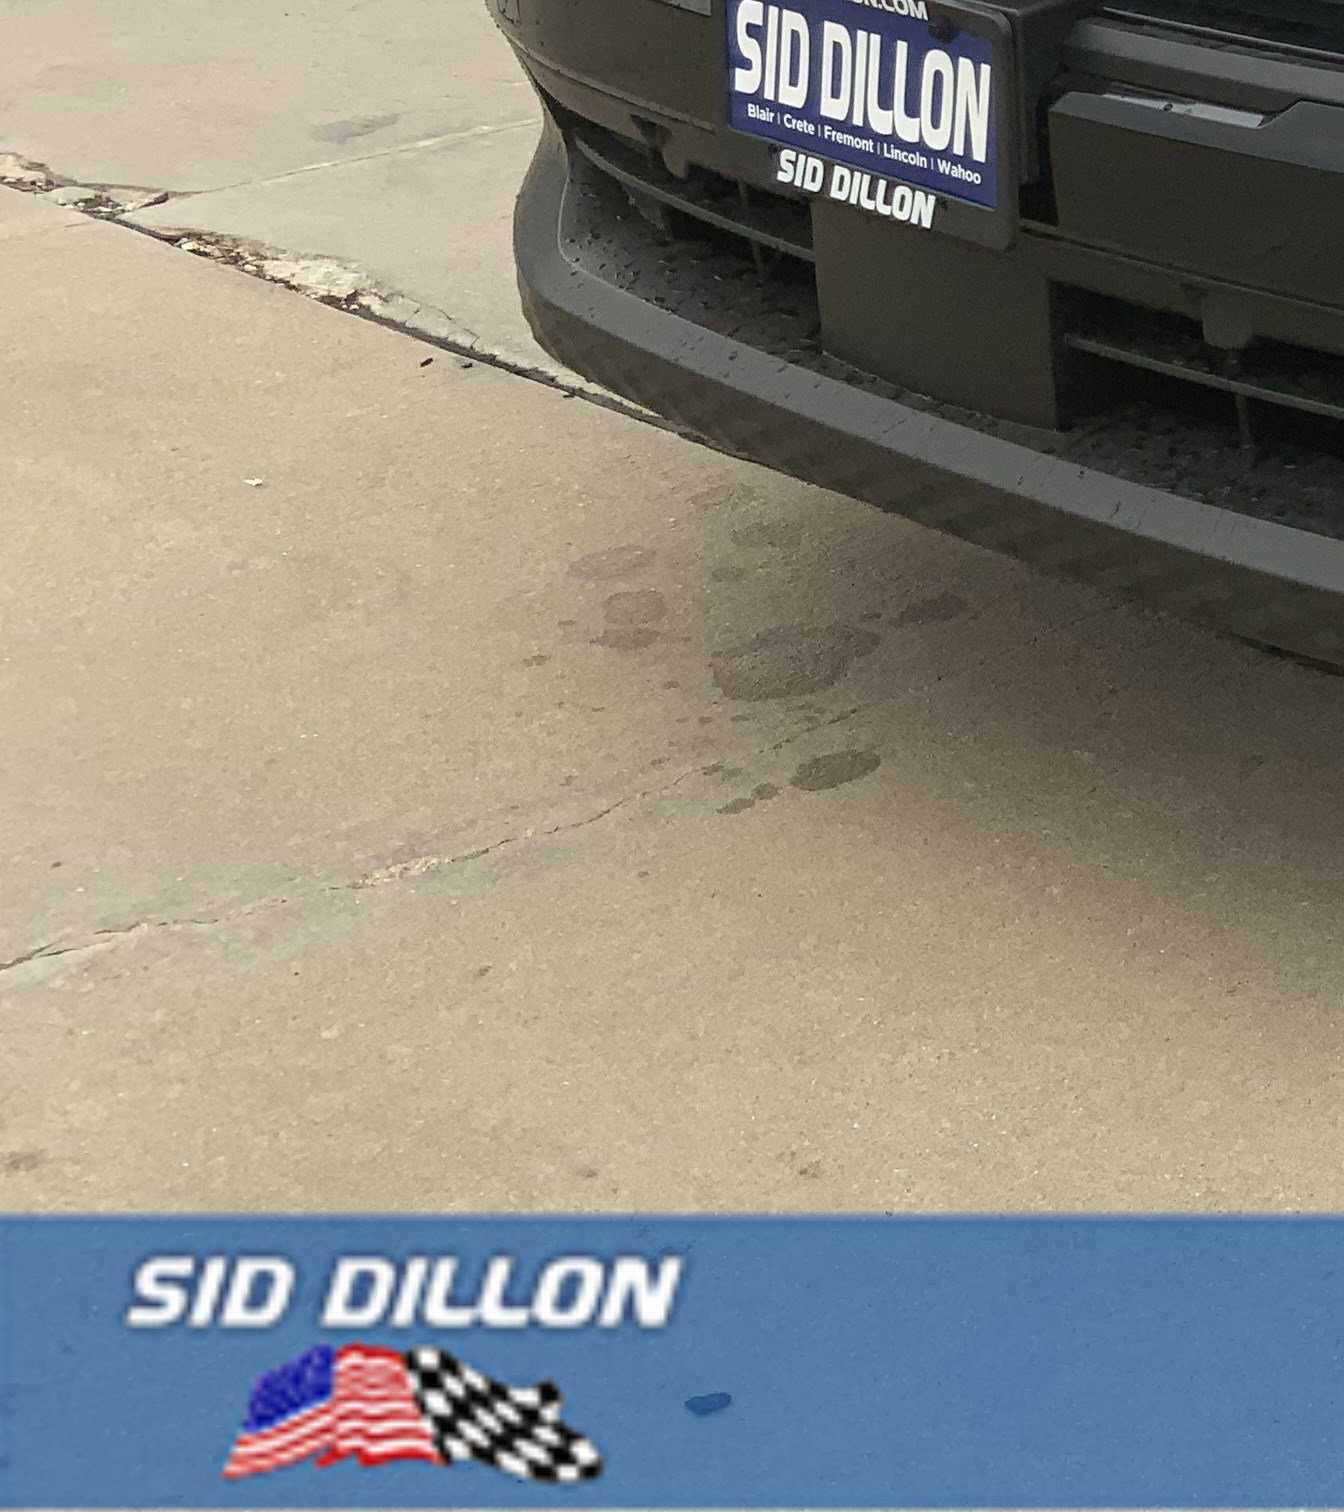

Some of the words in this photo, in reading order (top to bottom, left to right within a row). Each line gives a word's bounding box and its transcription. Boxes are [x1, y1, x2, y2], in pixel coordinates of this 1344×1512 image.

[734, 0, 810, 110] SID
[819, 20, 991, 163] DILLON
[747, 103, 775, 123] Blair
[783, 109, 815, 135] Crete
[824, 128, 874, 153] Fremont
[883, 143, 927, 168] Lincoln
[937, 159, 981, 185] Wahoo
[777, 149, 824, 192] SID
[830, 166, 936, 229] DILLON
